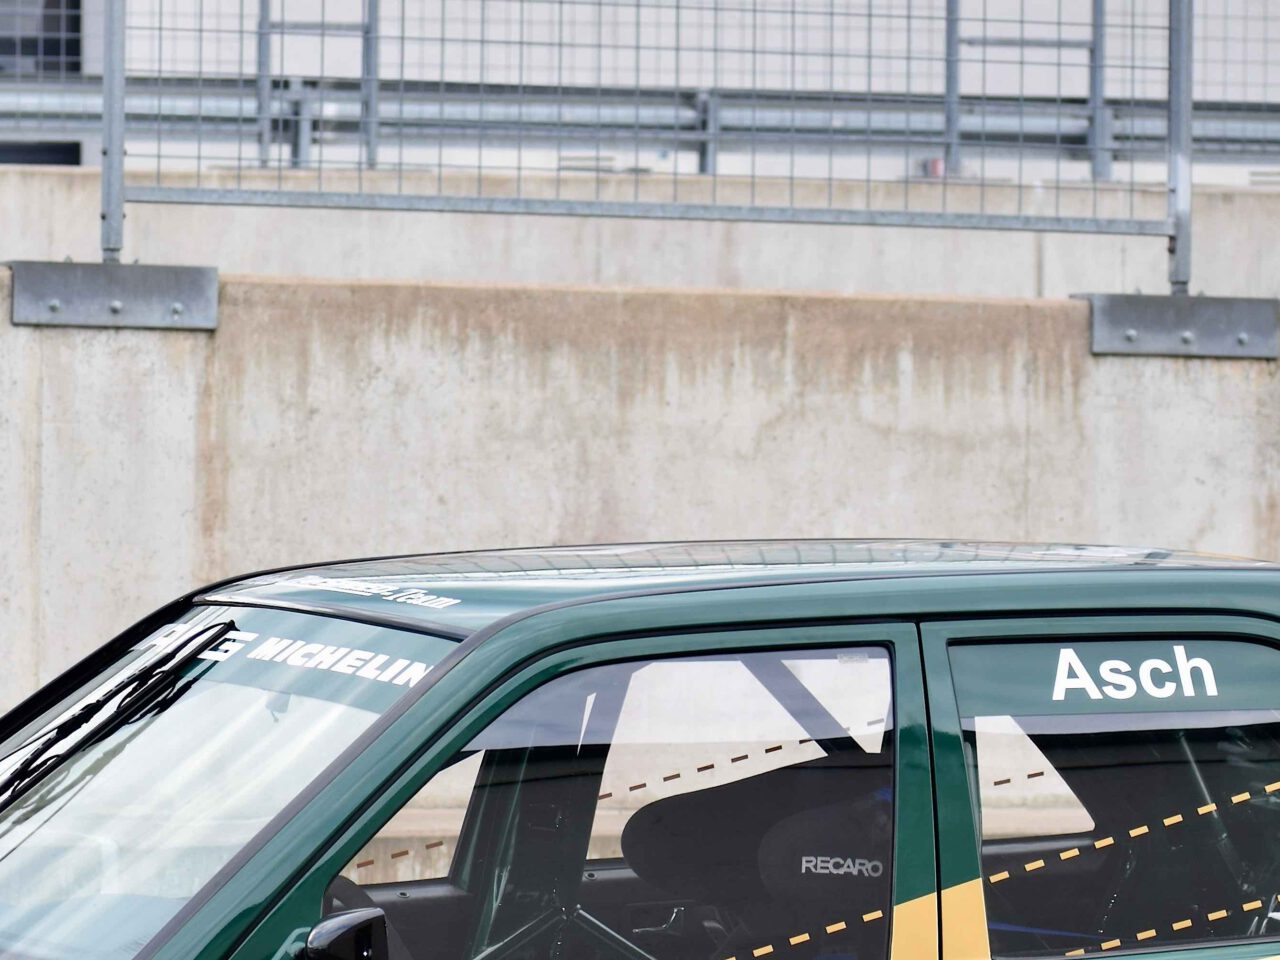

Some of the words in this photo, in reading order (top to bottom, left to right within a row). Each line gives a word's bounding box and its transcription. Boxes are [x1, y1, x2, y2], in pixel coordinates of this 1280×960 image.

[246, 636, 434, 688] MICHELIN
[1051, 645, 1219, 701] Asch
[800, 855, 883, 877] RECARO
